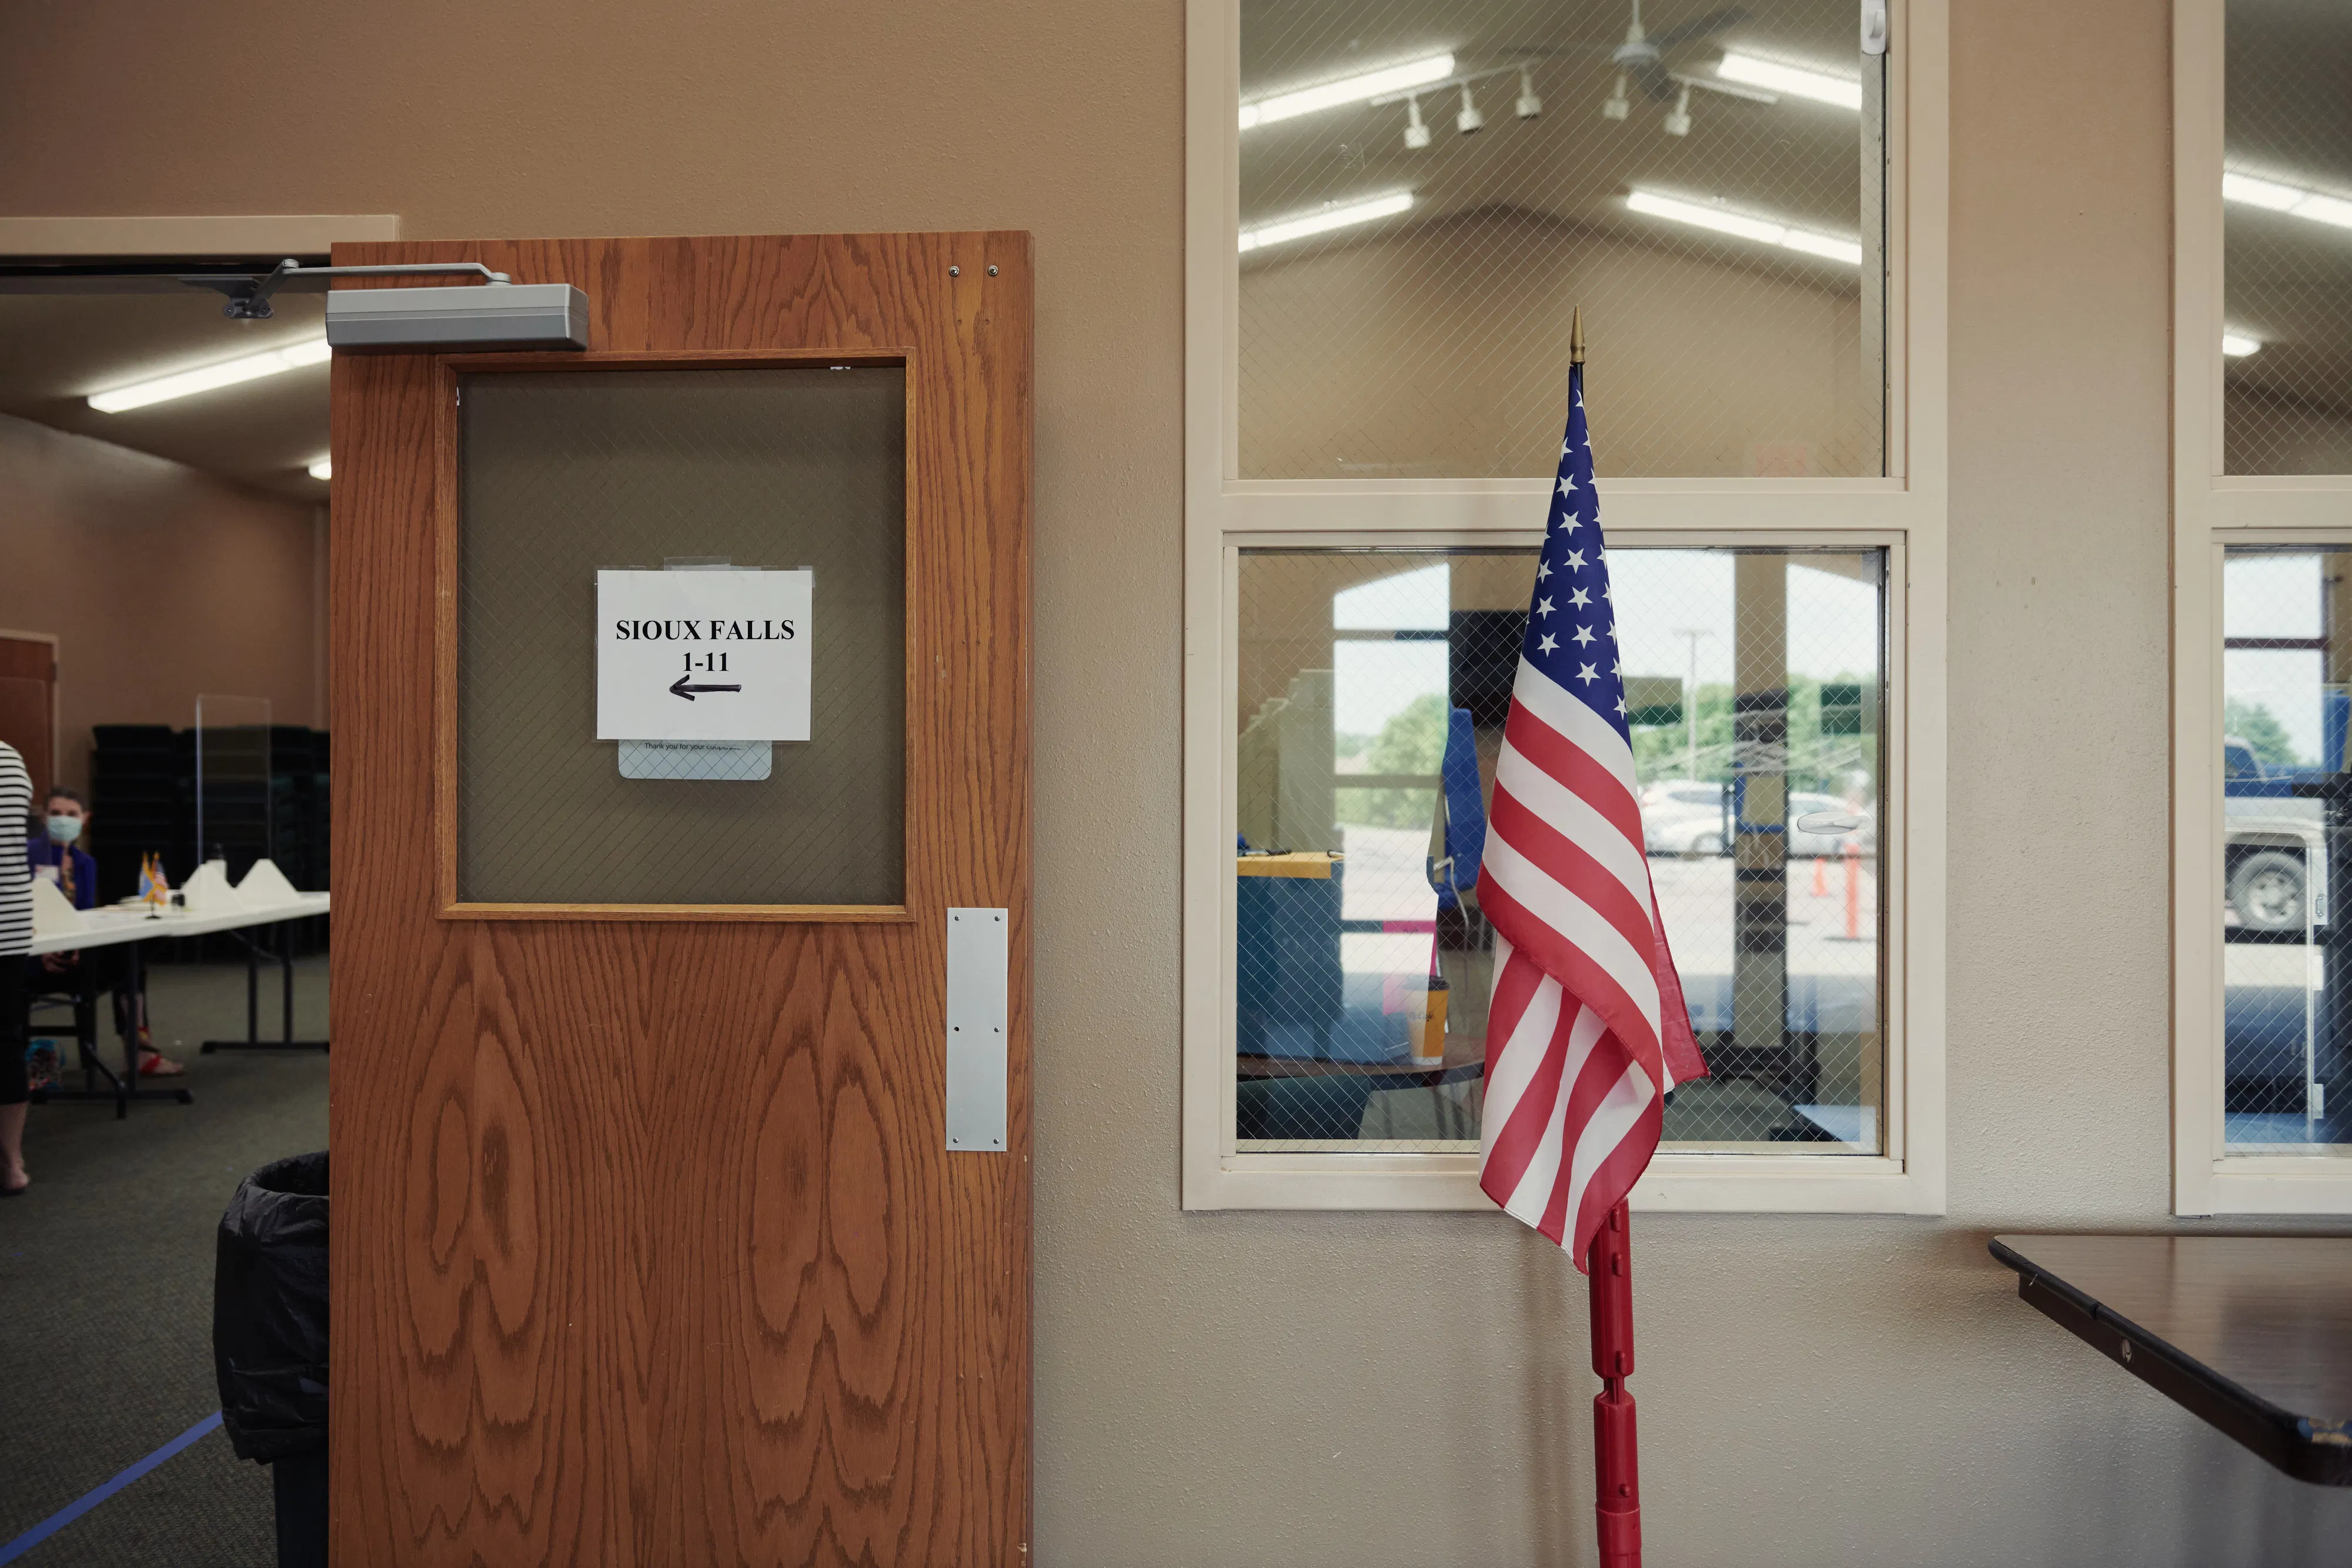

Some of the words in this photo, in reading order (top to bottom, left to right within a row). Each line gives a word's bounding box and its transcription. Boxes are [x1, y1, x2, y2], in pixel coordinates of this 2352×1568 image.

[616, 620, 702, 641] SIOUX
[709, 620, 795, 641] FALLS
[683, 651, 729, 672] 1-11
